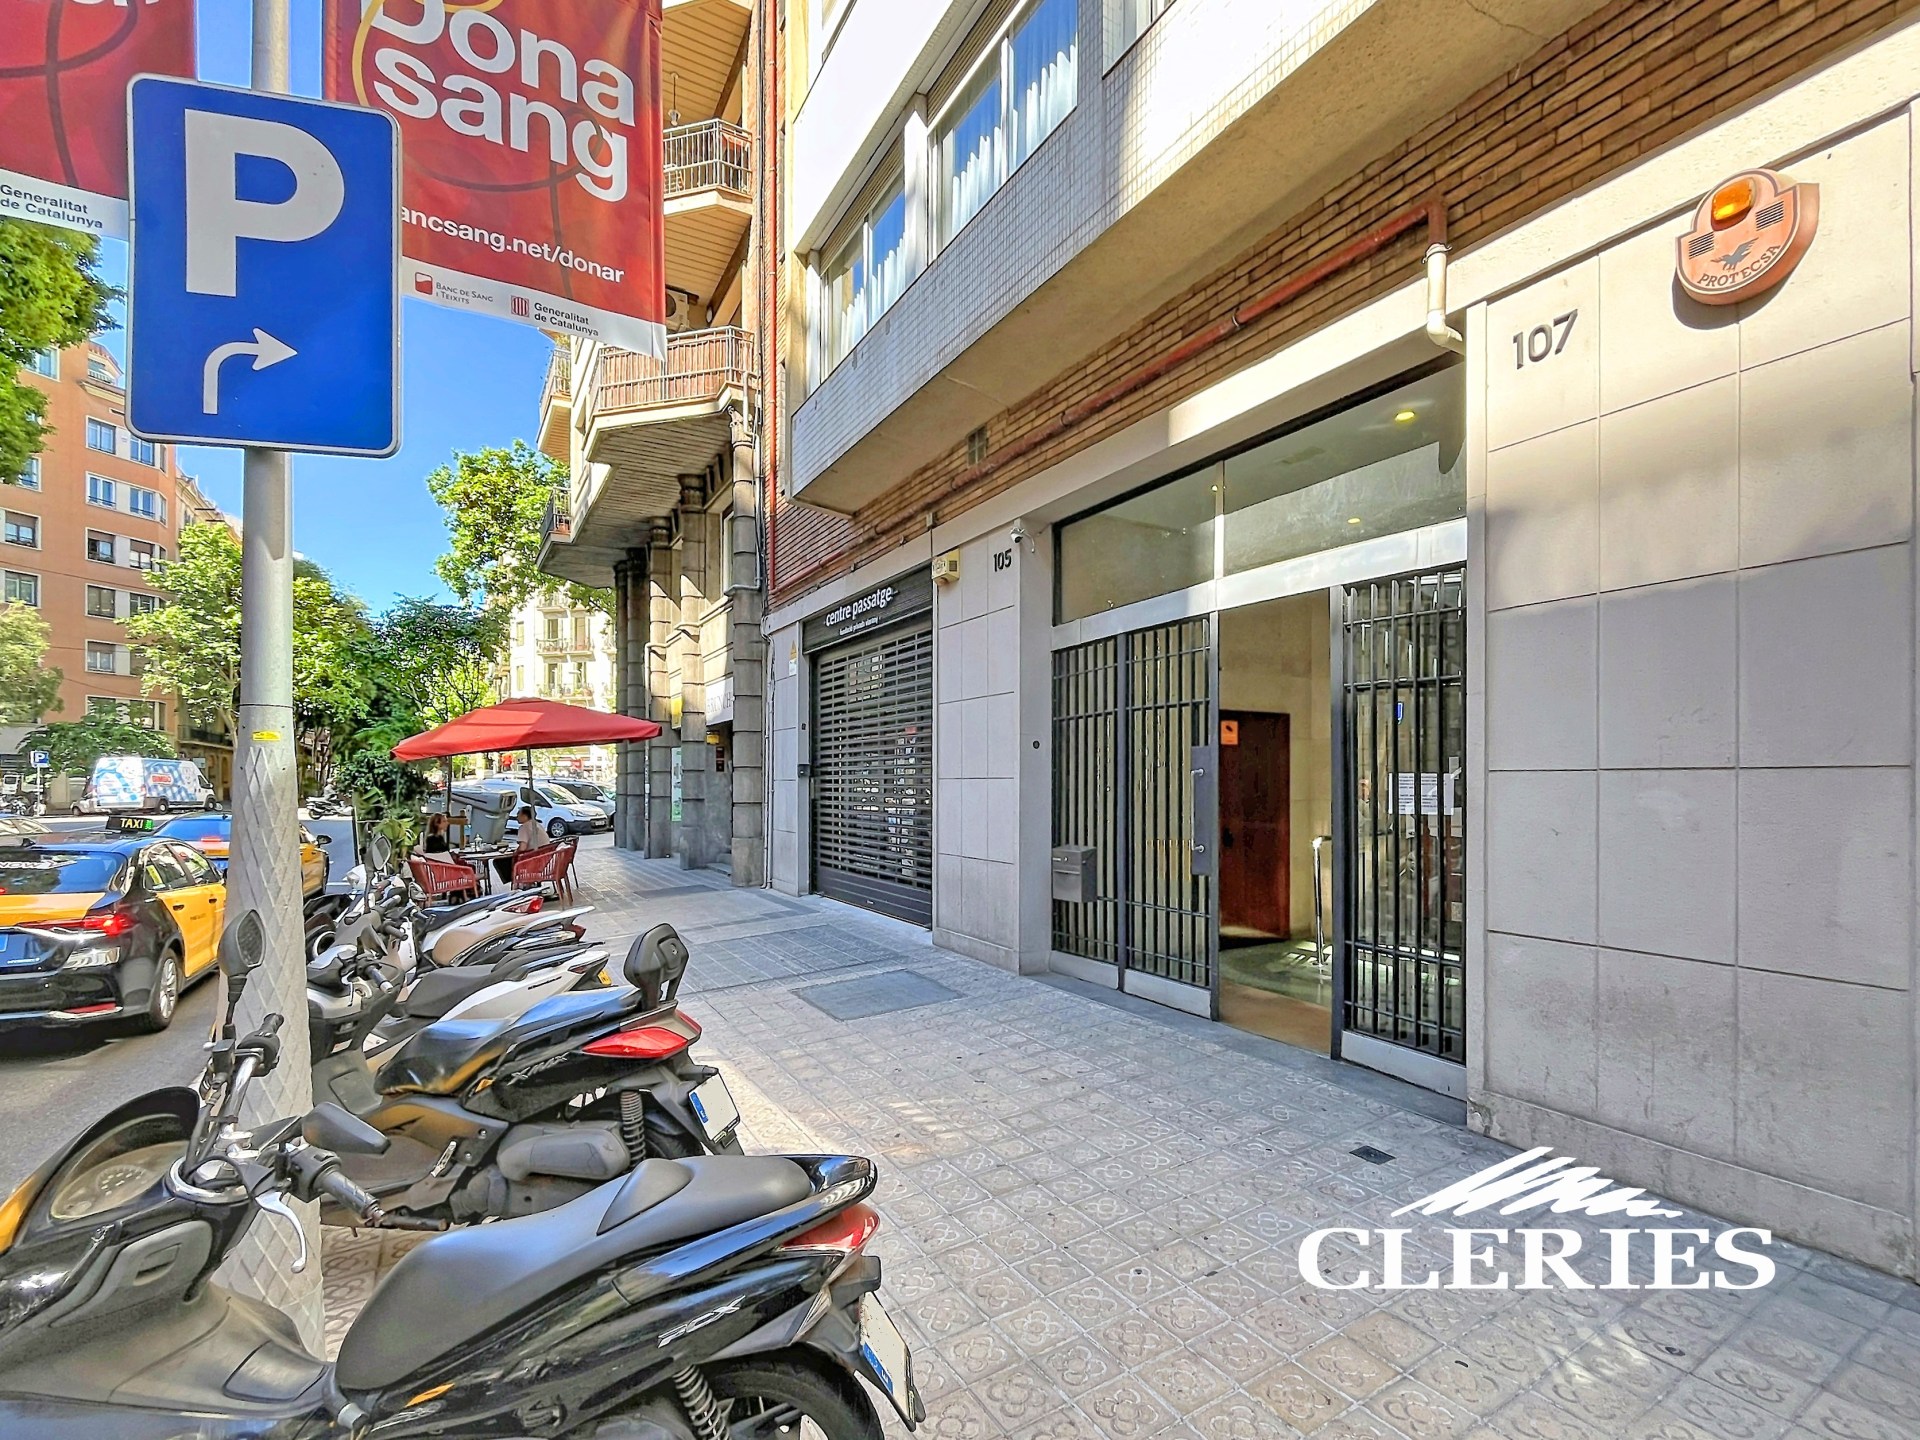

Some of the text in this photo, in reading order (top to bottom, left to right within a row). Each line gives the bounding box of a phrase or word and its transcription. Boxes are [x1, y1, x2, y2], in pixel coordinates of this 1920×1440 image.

[373, 47, 628, 202] sang
[0, 184, 88, 214] Generalitat
[0, 198, 104, 229] de Catalunya
[185, 108, 346, 298] P
[401, 206, 625, 284] ancsang.net/donar
[1697, 244, 1781, 288] PROTECSA
[534, 301, 590, 325] Generalitat
[534, 312, 599, 337] de Catalunya
[1512, 308, 1579, 370] 107
[993, 548, 1012, 572] 105
[825, 586, 893, 627] centre passatge
[35, 753, 45, 762] P
[120, 818, 144, 829] TAXI
